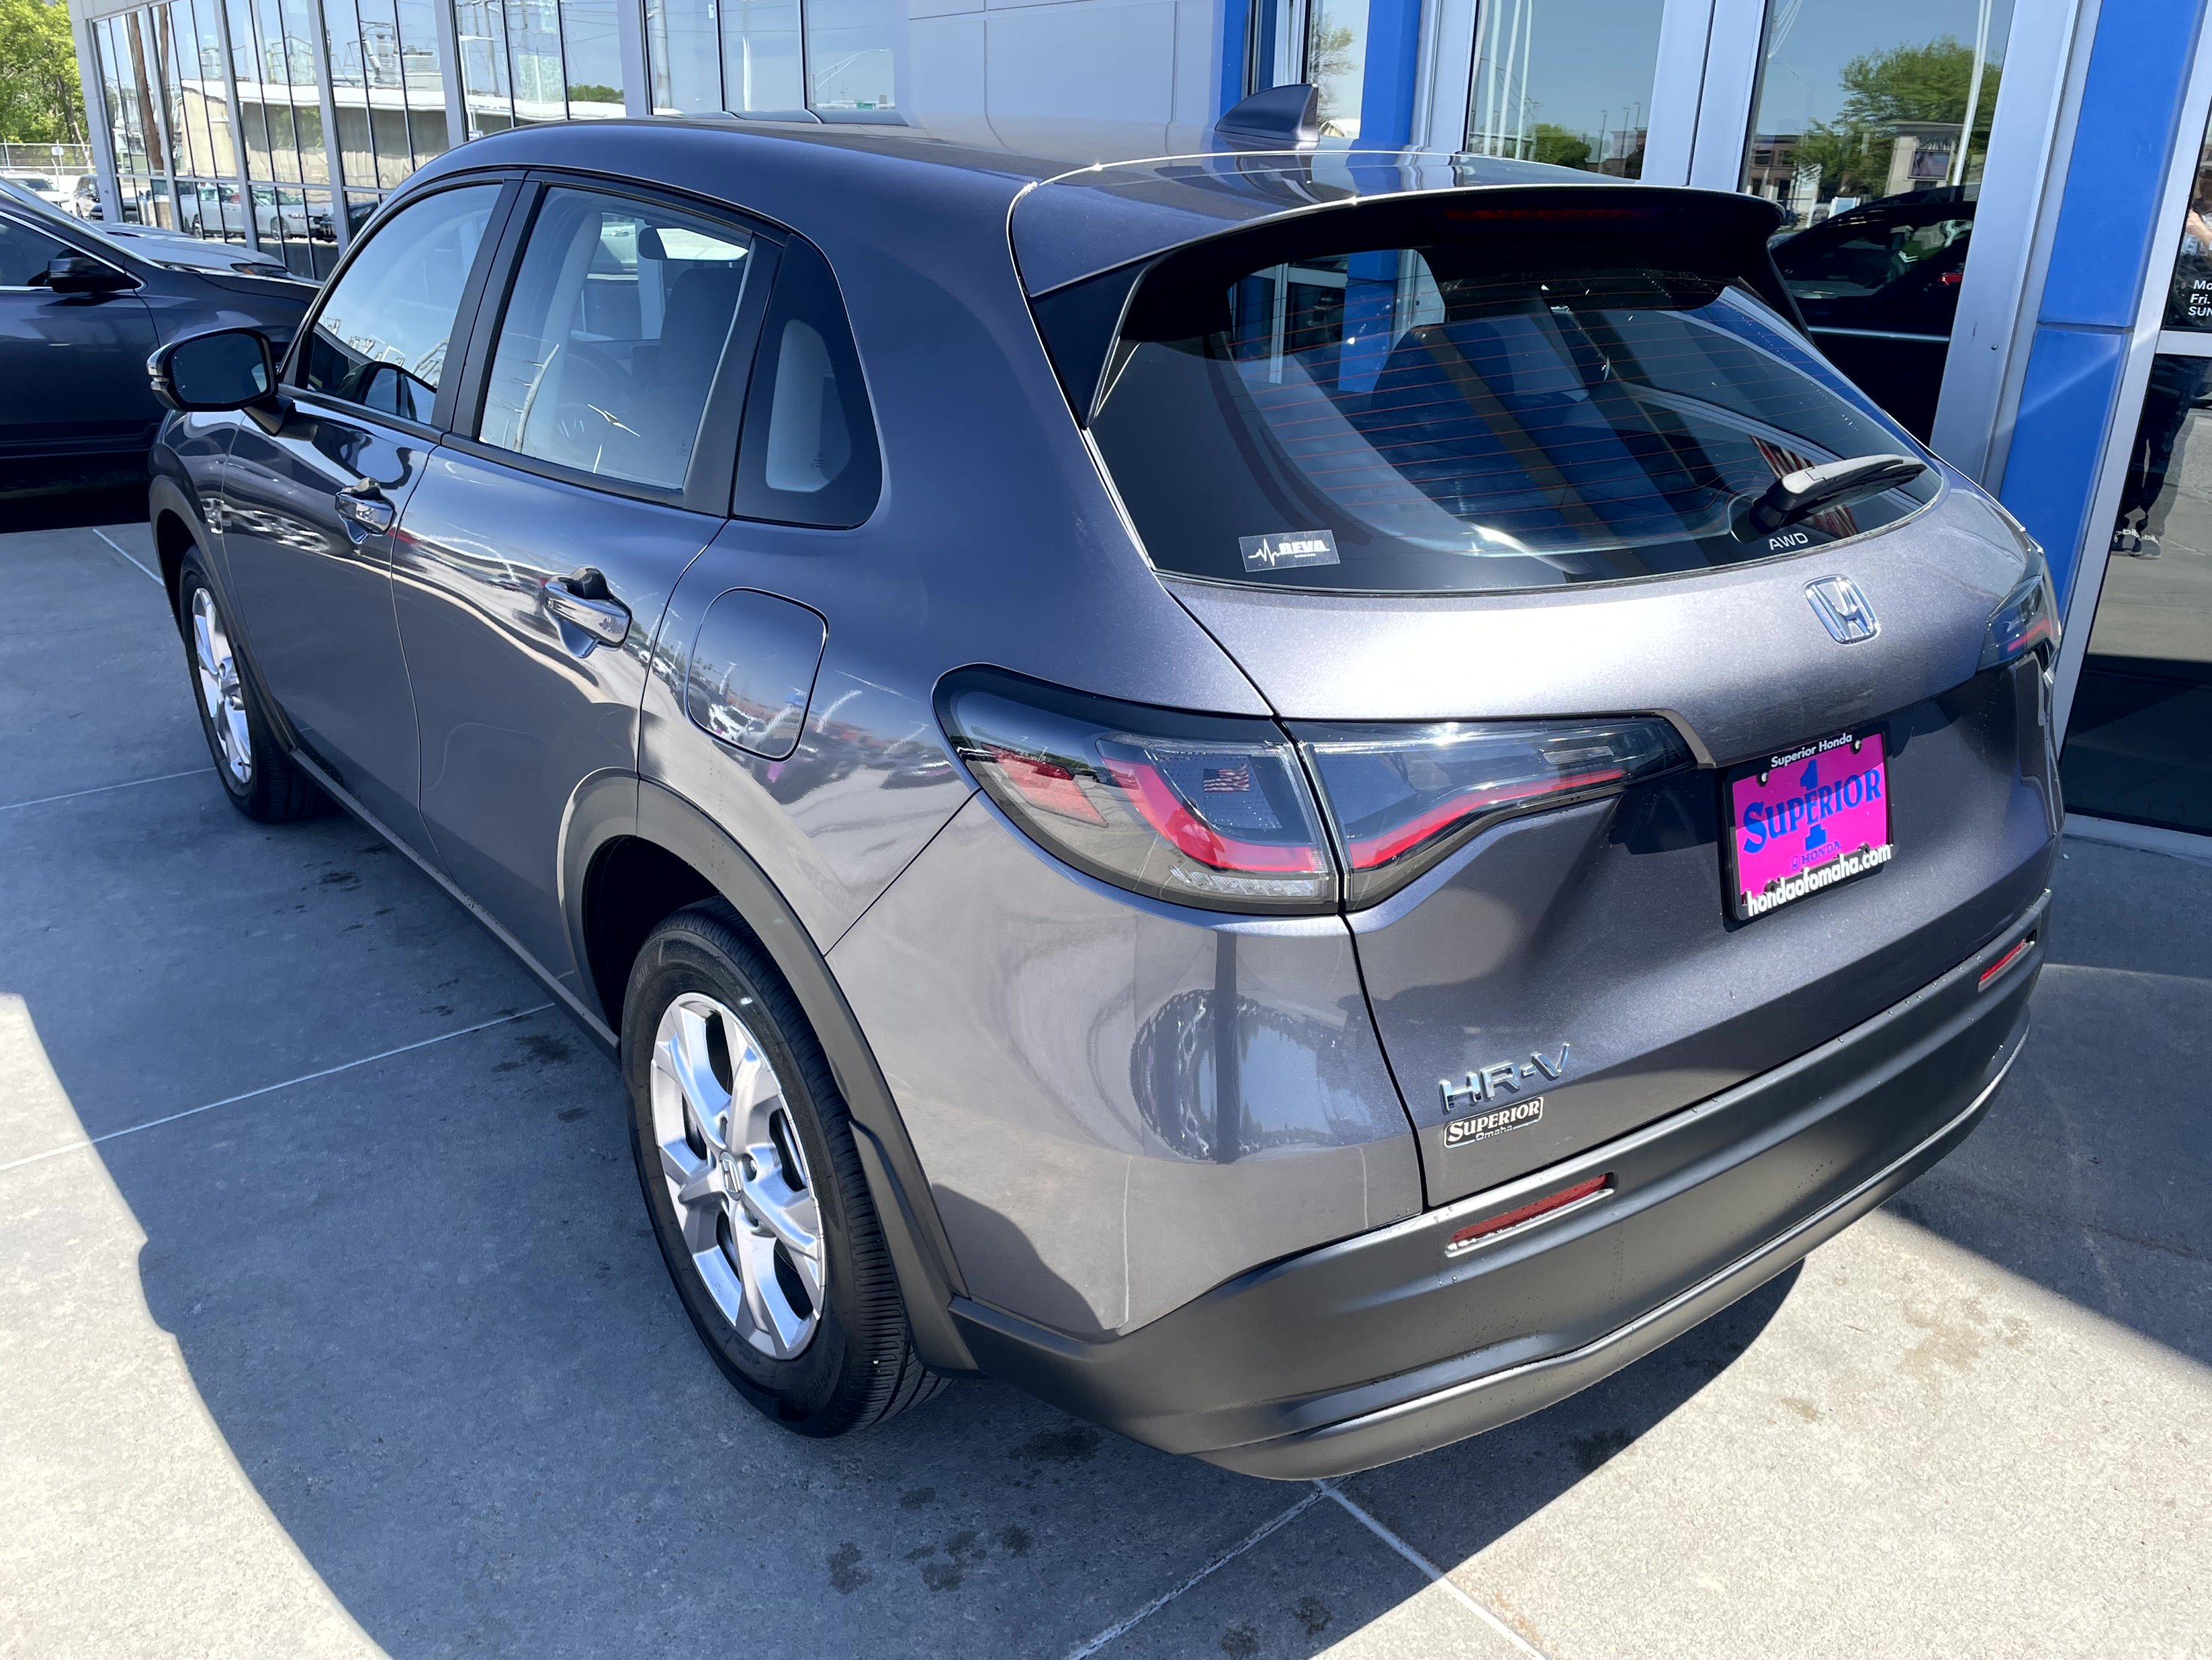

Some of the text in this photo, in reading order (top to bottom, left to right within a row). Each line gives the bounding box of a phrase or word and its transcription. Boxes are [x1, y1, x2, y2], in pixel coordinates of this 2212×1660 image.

[2190, 293, 2211, 304] Fri.
[1279, 540, 1327, 555] REVA
[1769, 532, 1809, 550] AWD
[1770, 733, 1853, 768] Superior Honda
[1743, 768, 1883, 854] SUPERIOR
[1801, 840, 1842, 865] HONDA
[1746, 844, 1893, 917] hondaofomaha.com
[1439, 1042, 1570, 1112] HR-V
[1447, 1100, 1540, 1142] SUPERIOR
[1475, 1125, 1513, 1141] Omaha
